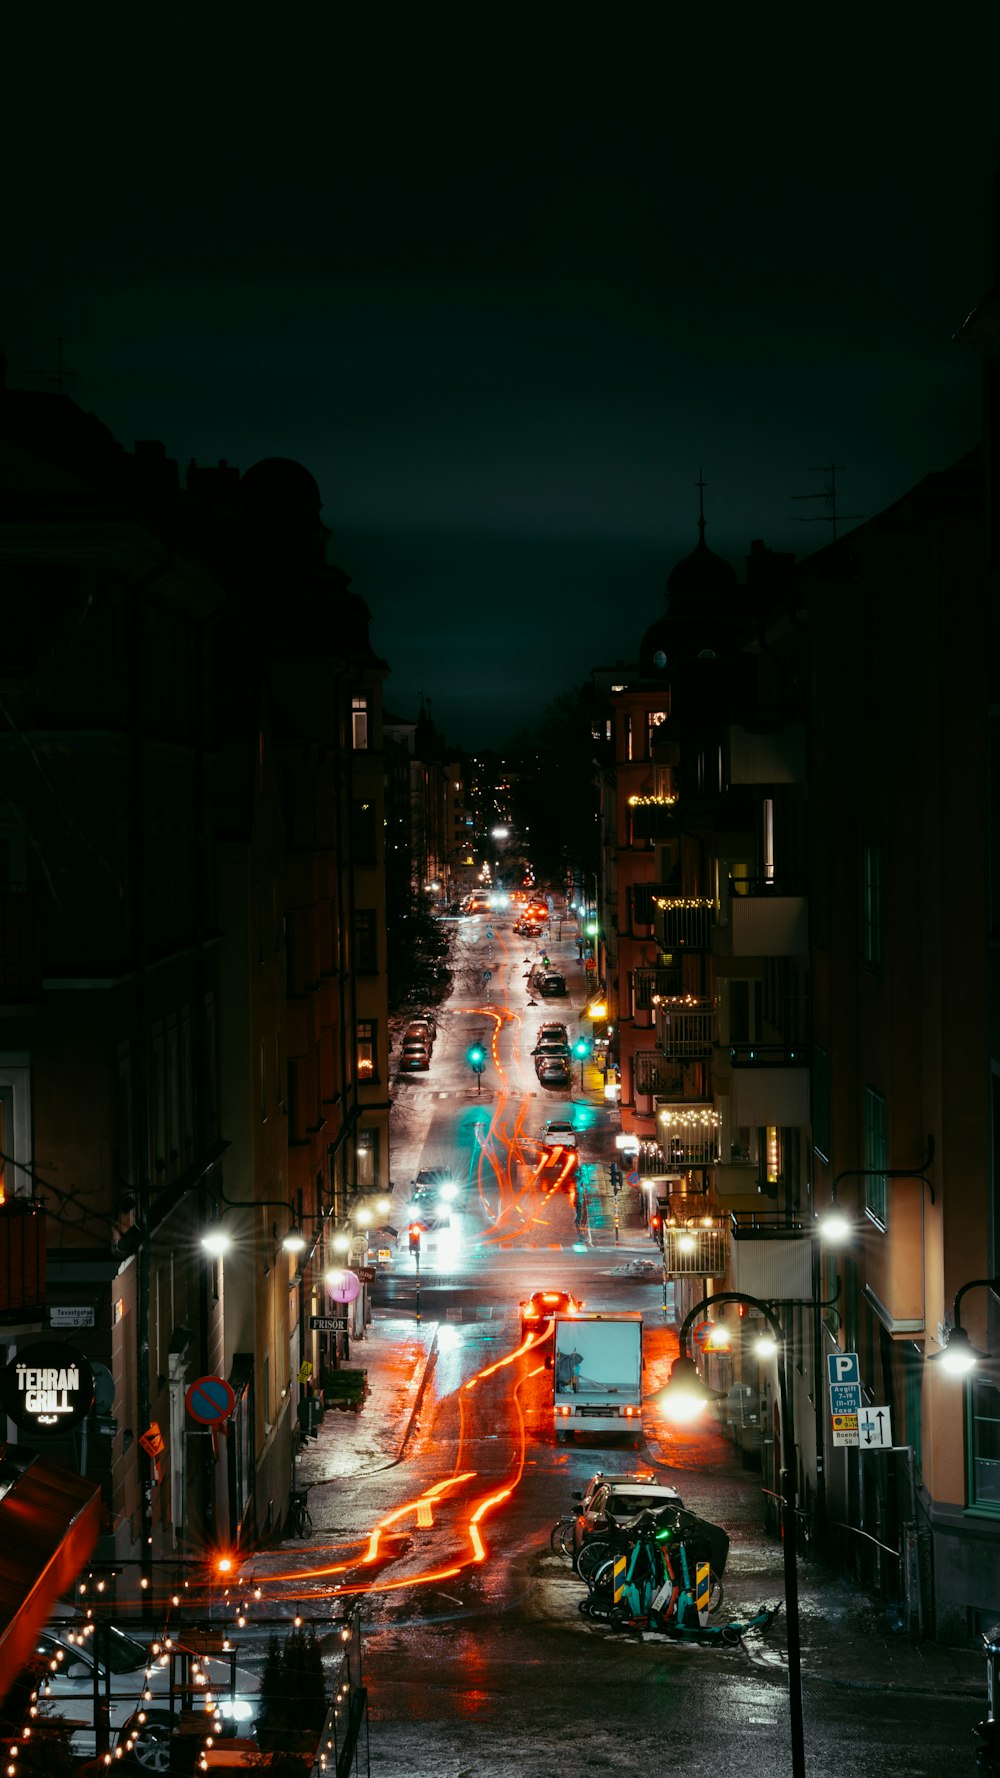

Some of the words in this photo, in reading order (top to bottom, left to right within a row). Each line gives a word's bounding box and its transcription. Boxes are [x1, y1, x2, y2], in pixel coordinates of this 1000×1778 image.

[313, 1318, 344, 1330] FRISÖR
[835, 1357, 853, 1381] P
[25, 1390, 74, 1412] GRILL
